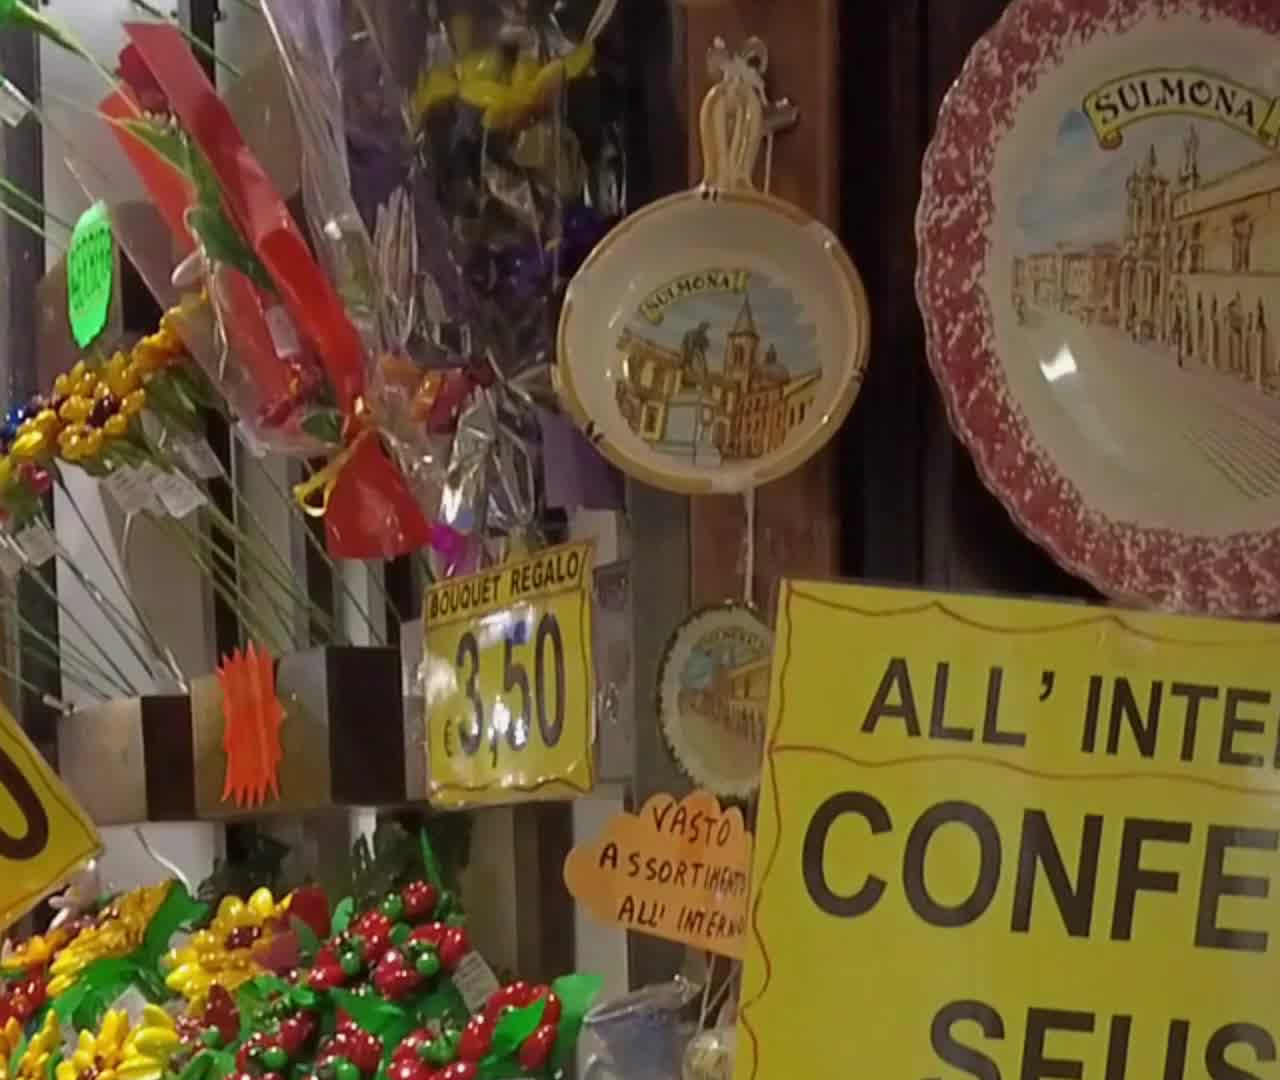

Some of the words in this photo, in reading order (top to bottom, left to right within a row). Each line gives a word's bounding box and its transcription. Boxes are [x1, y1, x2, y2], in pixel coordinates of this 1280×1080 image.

[1093, 79, 1257, 127] SULMONA
[647, 274, 730, 309] SULMONA
[430, 575, 501, 619] BOUQUET
[510, 551, 580, 596] REGALO
[455, 612, 566, 770] 3,50
[652, 801, 732, 847] VASTO
